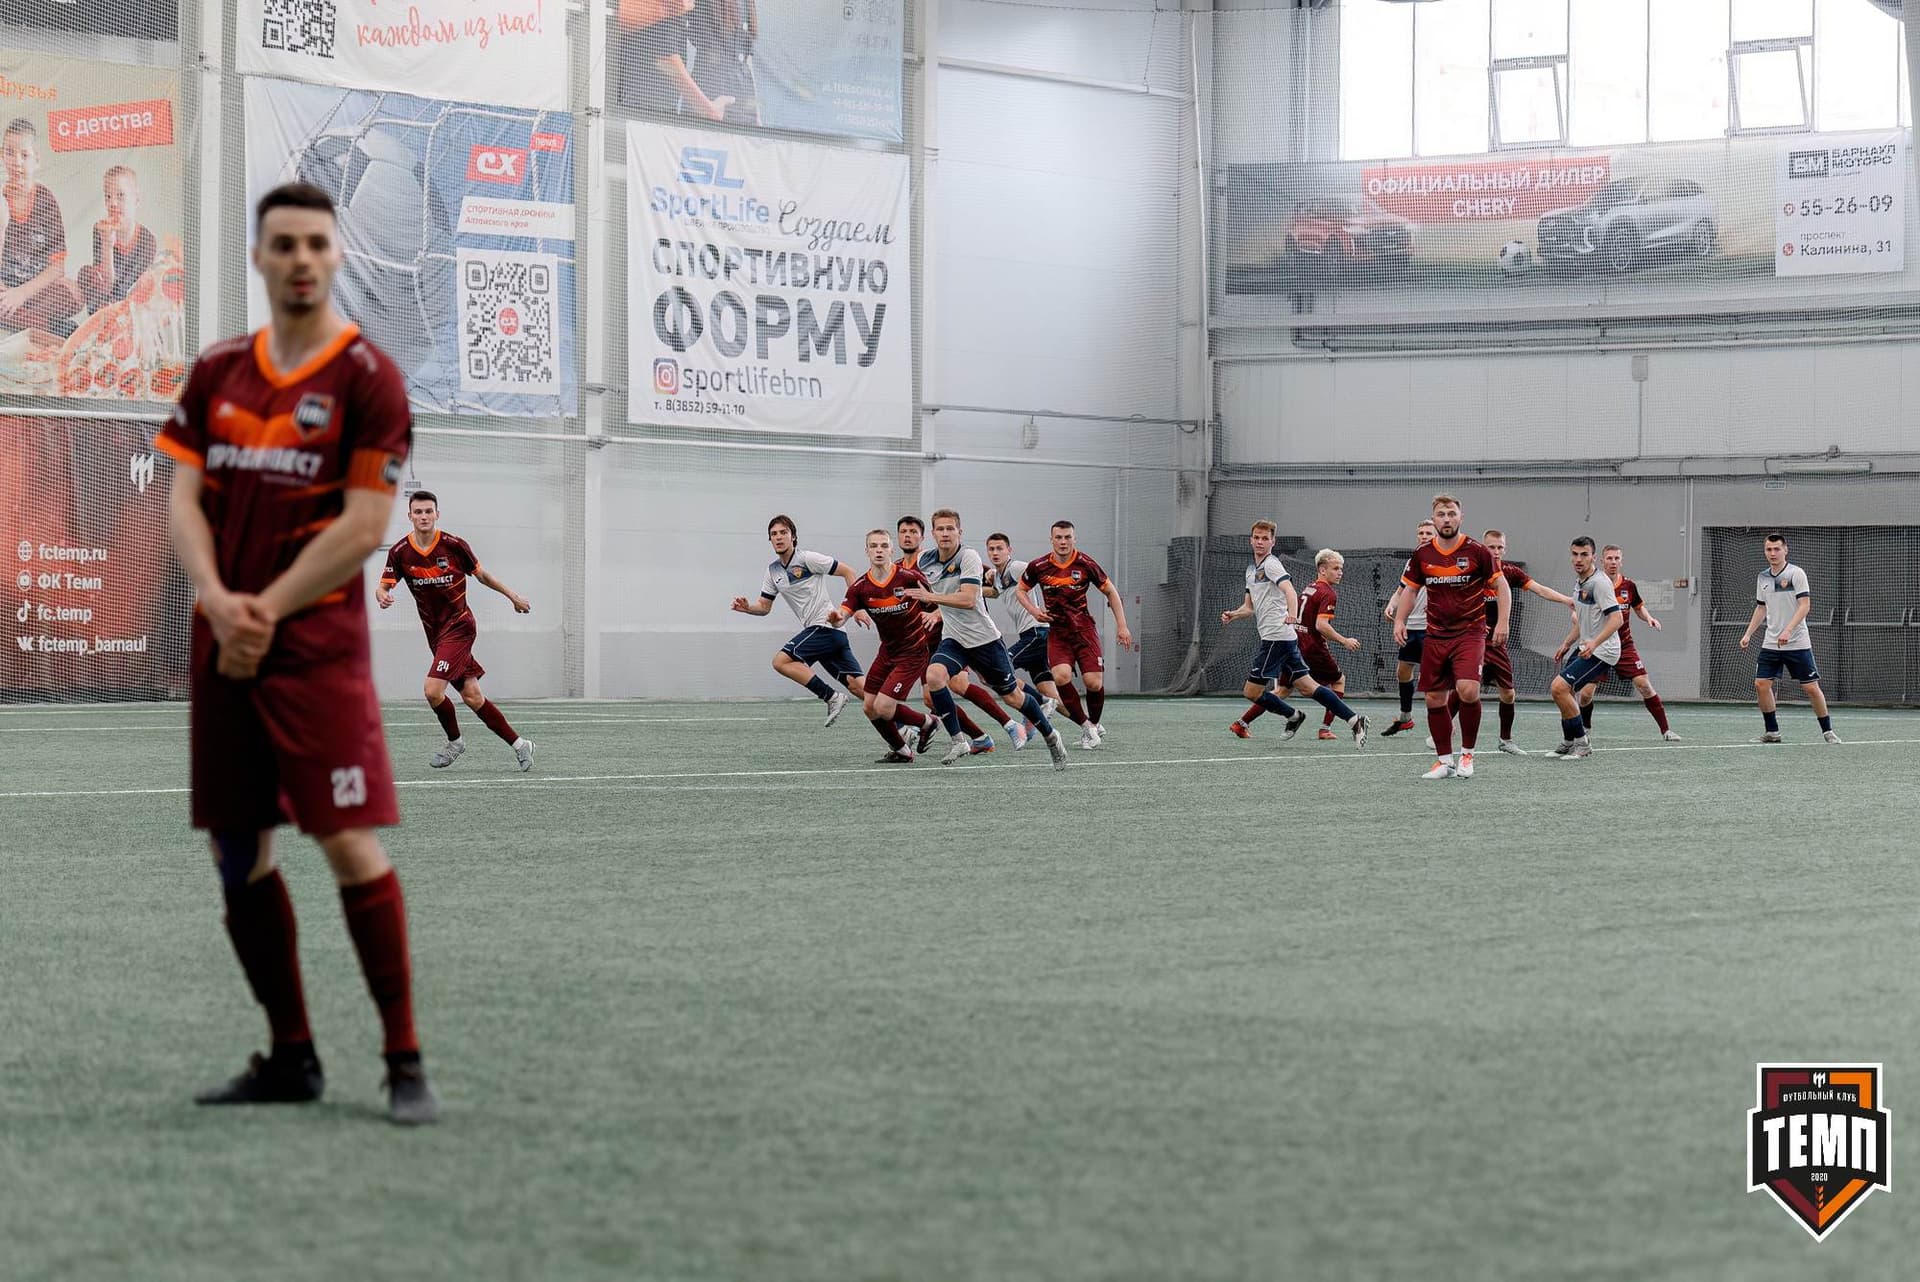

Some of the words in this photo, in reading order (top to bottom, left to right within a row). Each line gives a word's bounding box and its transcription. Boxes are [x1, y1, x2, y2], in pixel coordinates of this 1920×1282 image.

[357, 6, 459, 47] каждом
[464, 16, 493, 49] из
[497, 0, 543, 36] нас!
[58, 121, 70, 137] с
[76, 111, 153, 138] детства
[1832, 144, 1896, 159] БАРНАУЛ
[1832, 156, 1893, 169] МОТОРС
[1368, 166, 1530, 196] ОФИЦИАЛЬНЫЙ
[1536, 167, 1605, 191] ДИЛЕР
[650, 186, 770, 223] SportLife
[1453, 196, 1517, 217] CHERY
[1800, 194, 1893, 217] 55-26-09
[777, 199, 896, 251] Создаем
[1800, 232, 1846, 242] проспект
[1800, 243, 1872, 256] Калинина,
[1876, 240, 1891, 253] 31
[652, 238, 889, 294] СПОРТИВНУЮ
[653, 286, 887, 367] ФОРМУ
[682, 366, 823, 398] sportlifebrn
[666, 399, 704, 414] 8(3852)
[38, 543, 108, 563] fctemp.ru
[37, 573, 61, 589] ФК
[64, 574, 102, 590] Темп
[37, 605, 92, 623] fc.temp
[38, 635, 147, 655] fctemp_barnaul
[436, 660, 450, 672] 24
[331, 765, 367, 808] 23
